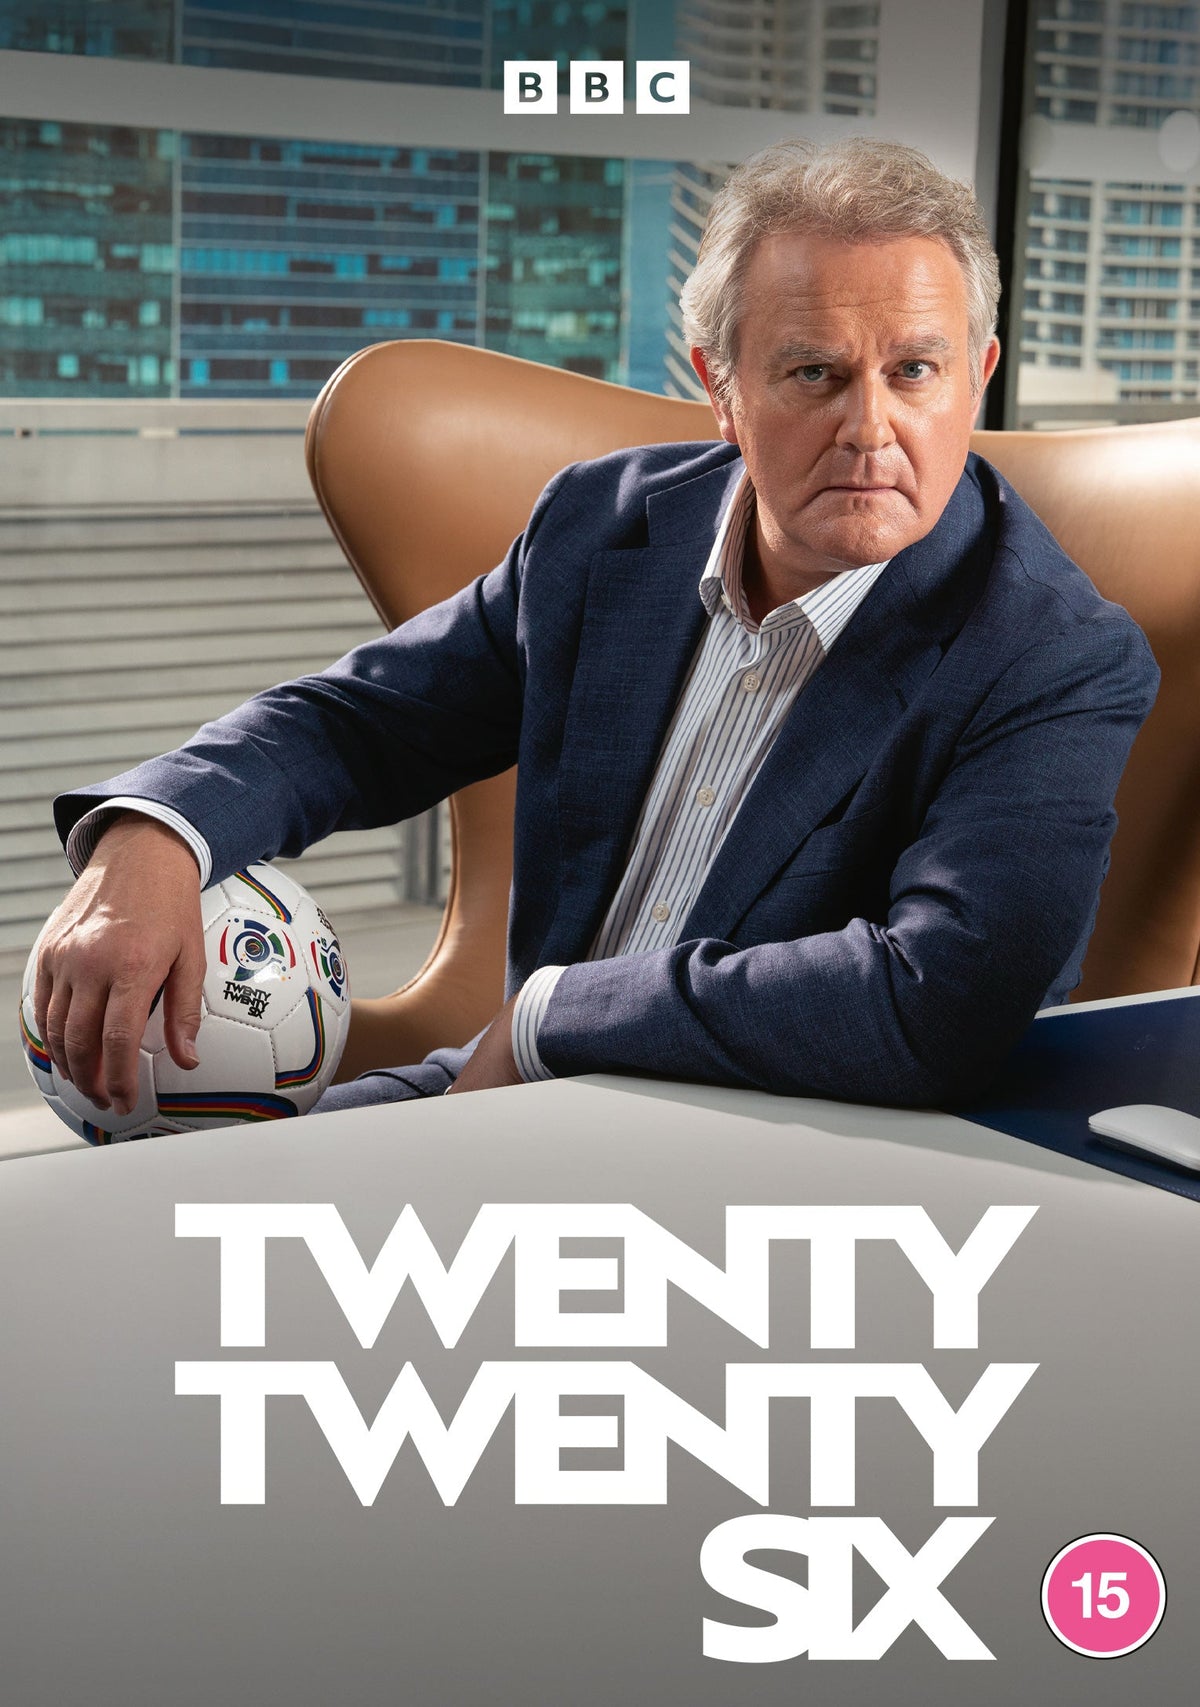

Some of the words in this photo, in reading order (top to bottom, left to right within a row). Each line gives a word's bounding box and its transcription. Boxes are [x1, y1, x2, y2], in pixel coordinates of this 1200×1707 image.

[223, 990, 269, 1011] TWENTY
[224, 981, 271, 1001] TWENTY
[248, 1006, 266, 1019] SIX
